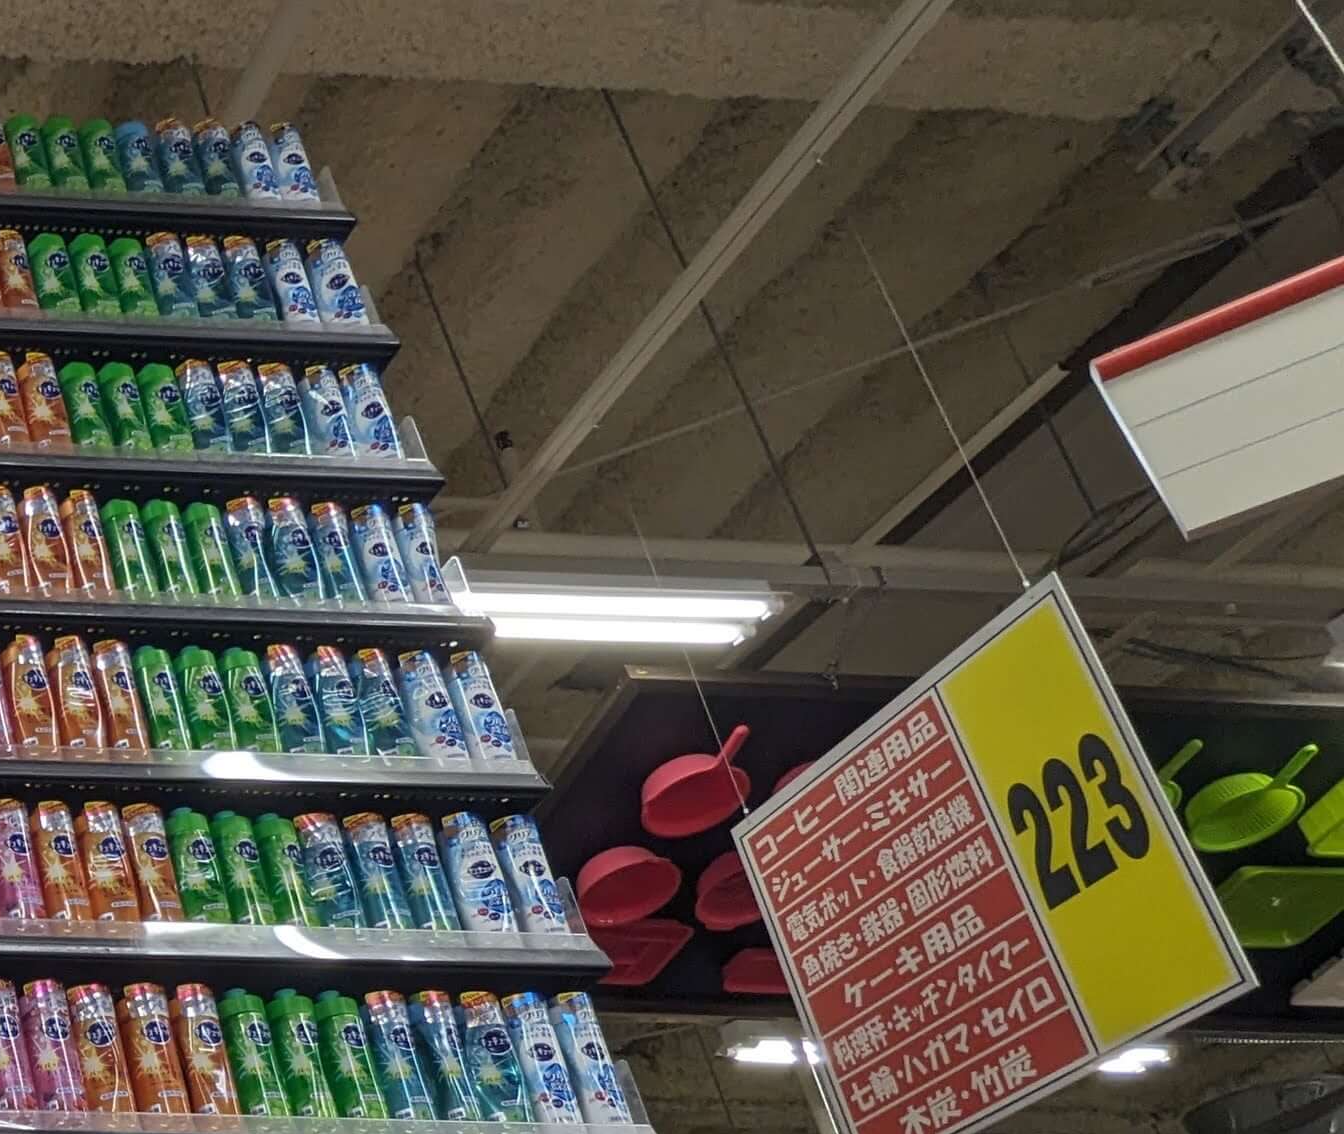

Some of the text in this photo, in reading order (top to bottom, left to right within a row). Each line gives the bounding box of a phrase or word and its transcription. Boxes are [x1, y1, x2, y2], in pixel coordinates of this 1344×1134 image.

[756, 712, 937, 865] コーヒー関連用品
[772, 761, 953, 901] ジューサー・ミキサー
[1007, 733, 1150, 911] 223
[786, 798, 976, 945] 電気ポット・食器乾燥機
[844, 905, 986, 1007] ケーキ用品
